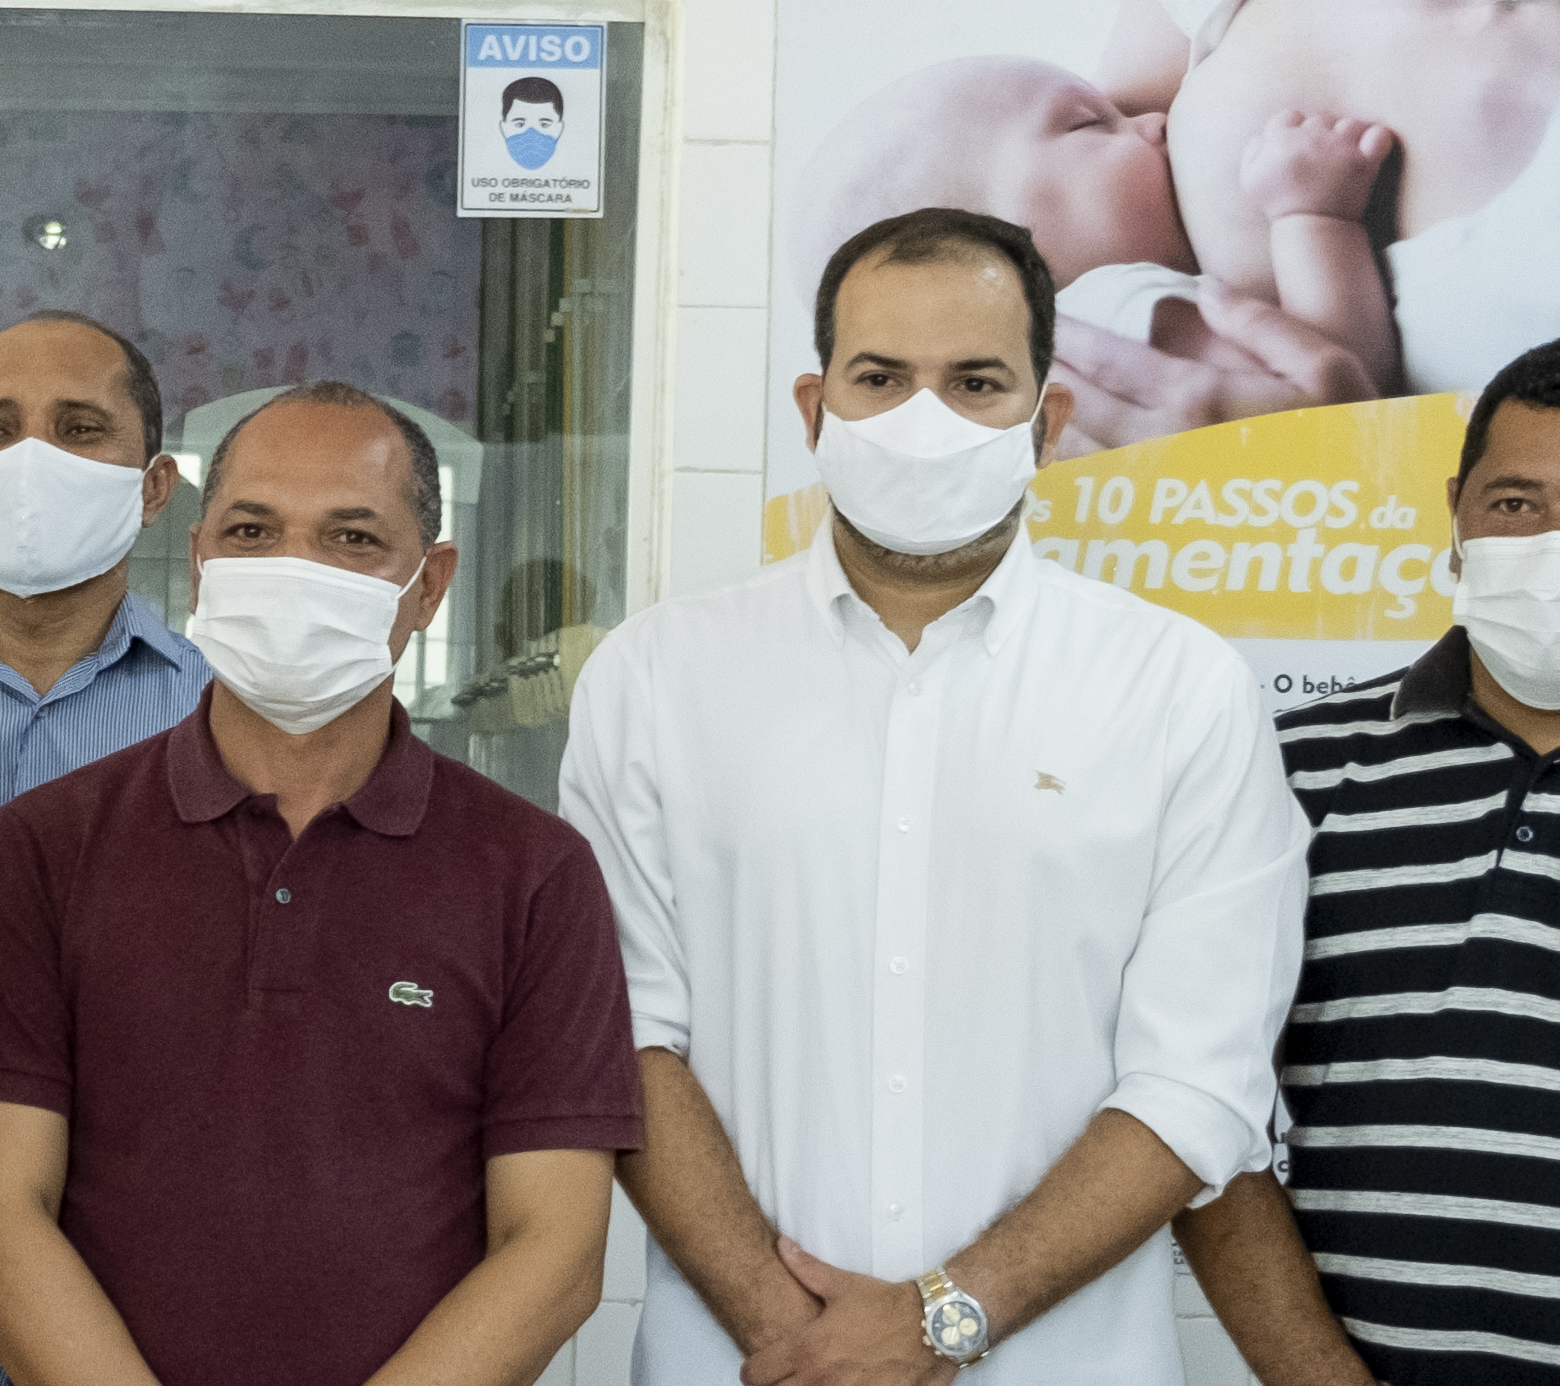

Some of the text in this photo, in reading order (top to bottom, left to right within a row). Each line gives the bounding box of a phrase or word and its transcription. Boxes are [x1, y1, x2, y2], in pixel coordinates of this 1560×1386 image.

[477, 34, 591, 63] AVISO
[471, 176, 590, 190] USO OBRIGATÓRIO
[488, 191, 572, 204] DE MÁSCARA
[1074, 475, 1136, 525] 10
[1148, 477, 1360, 529] PASSOS
[1369, 494, 1417, 530] da
[1273, 674, 1293, 694] O
